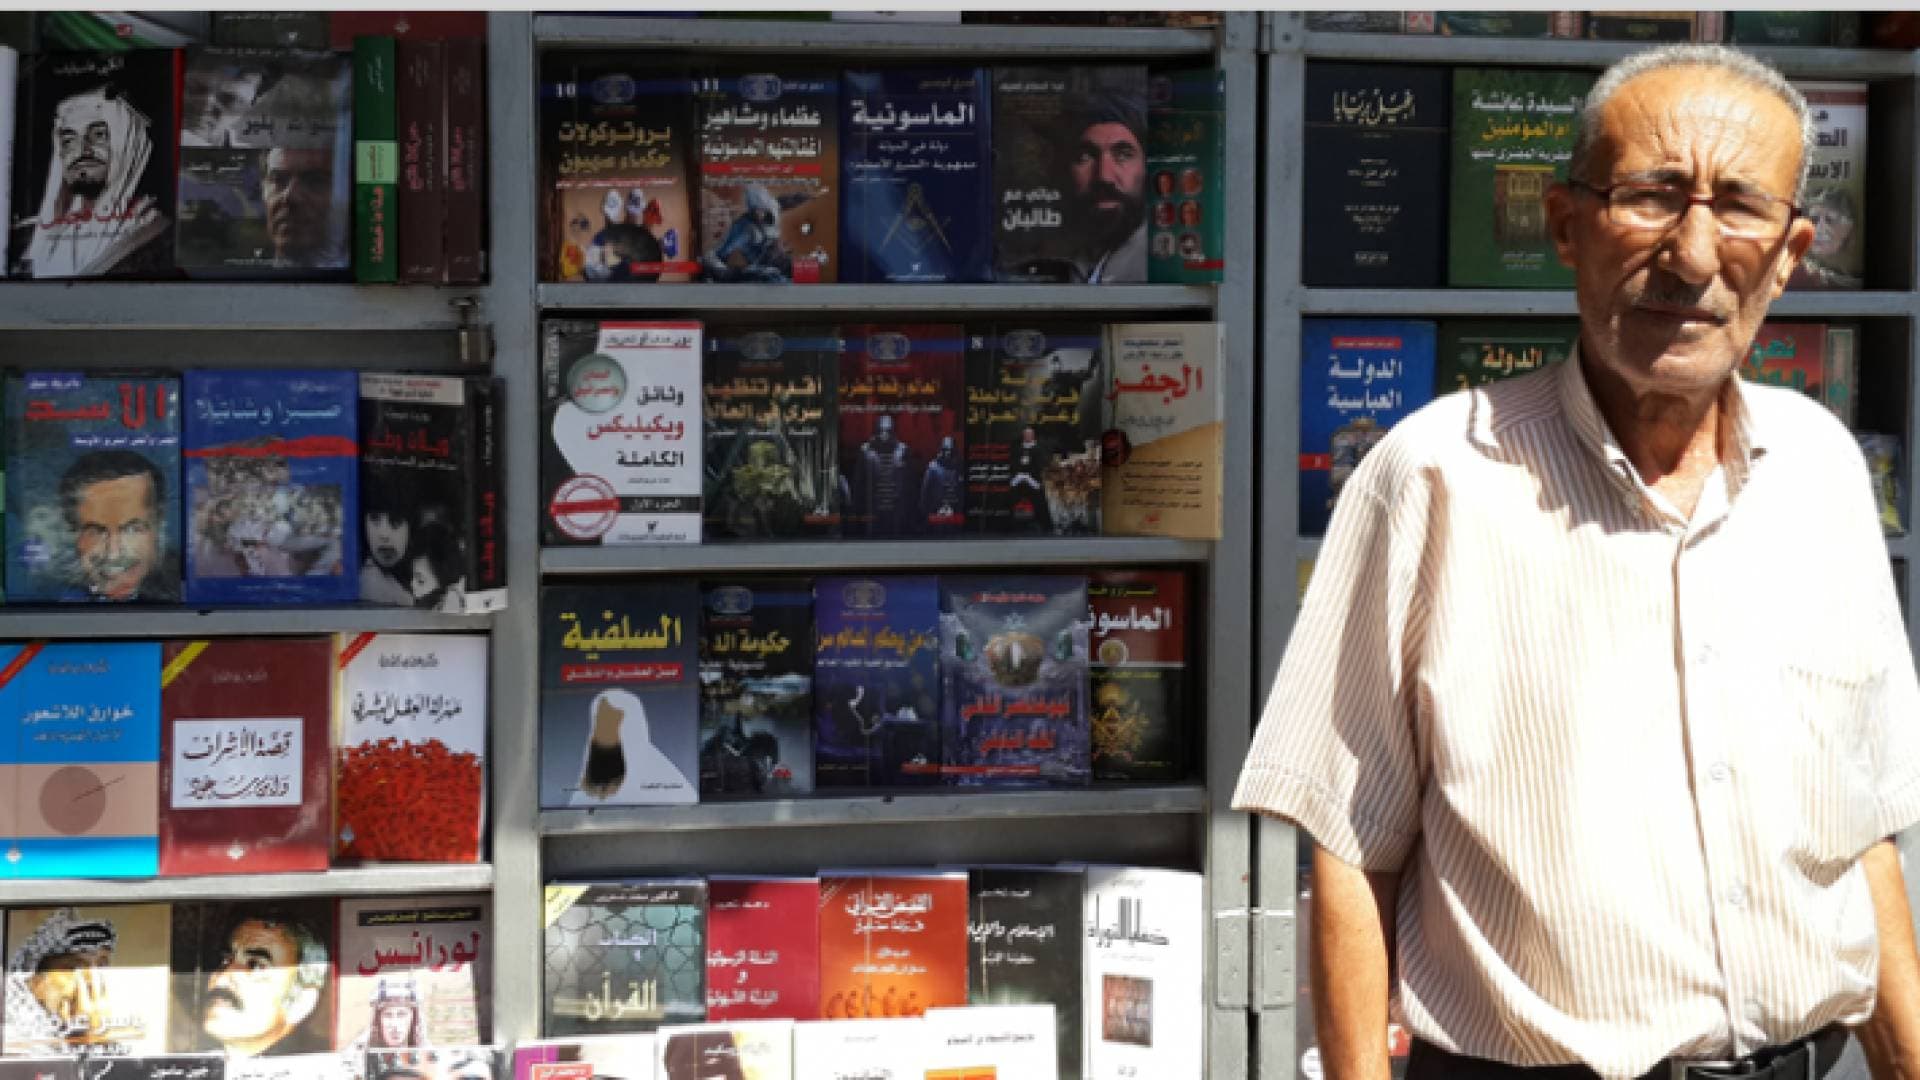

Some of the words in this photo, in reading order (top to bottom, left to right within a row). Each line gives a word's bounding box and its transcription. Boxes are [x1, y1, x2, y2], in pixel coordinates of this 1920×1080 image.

[556, 82, 576, 98] 10
[1471, 88, 1524, 112] عائشة
[851, 98, 975, 130] الماسونية
[559, 120, 671, 147] بروتوكولات
[1480, 116, 1554, 142] المؤمنين
[619, 148, 671, 169] حكماء
[702, 134, 766, 161] الماسونية
[559, 151, 617, 174] صهيون
[1003, 188, 1022, 205] مع
[1024, 186, 1061, 202] حياتي
[1002, 207, 1062, 231] طالبان
[1327, 353, 1404, 385] الدولة
[1481, 344, 1543, 376] الدولة
[636, 384, 684, 407] وثائق
[1103, 363, 1204, 406] الجفر
[24, 382, 166, 430] الأسد
[1326, 384, 1404, 416] العباسية
[586, 414, 684, 440] ويكيليكس
[616, 450, 684, 467] الكاملة
[559, 609, 682, 661] السلفية
[1088, 606, 1171, 637] الماسون
[738, 628, 791, 658] حكومة
[22, 703, 85, 725] اللاشعور
[86, 704, 135, 723] خوارق
[182, 726, 257, 767] الأشراف
[255, 729, 293, 760] قصة
[357, 930, 480, 976] لورانس
[585, 971, 657, 1021] القرآن
